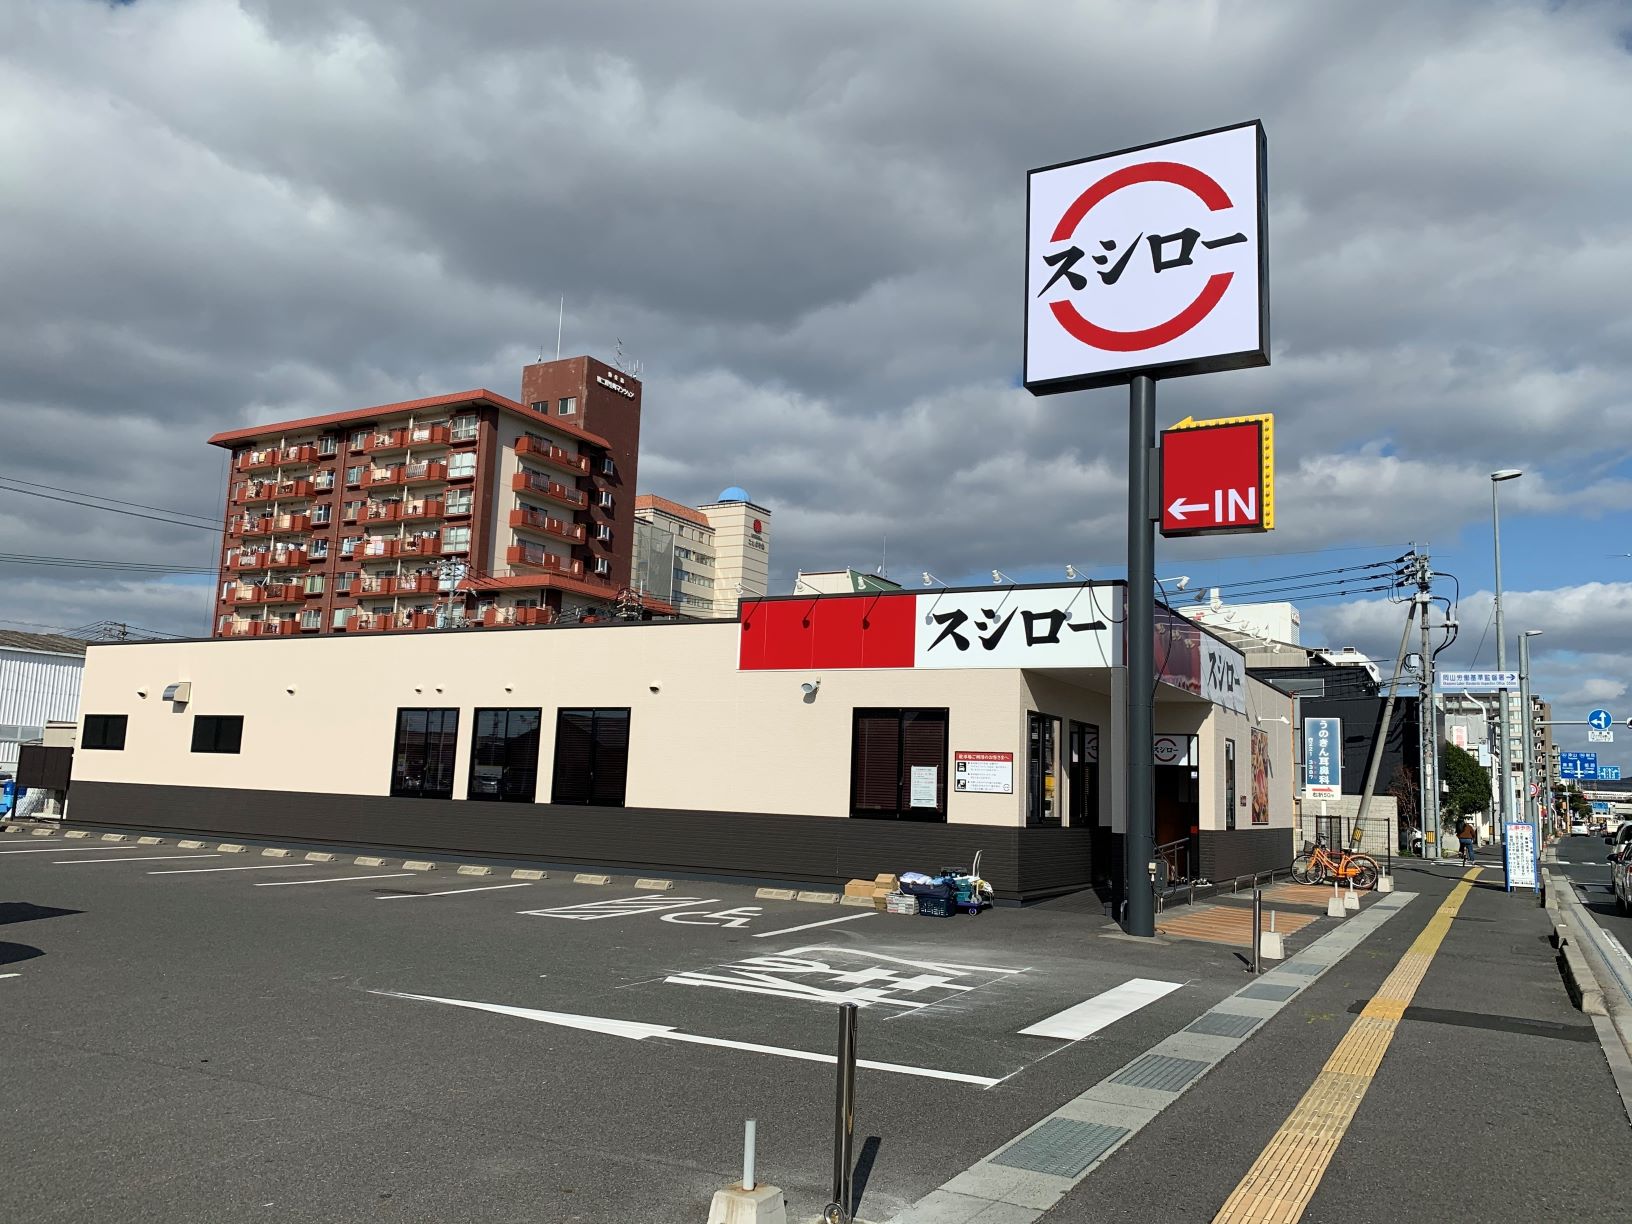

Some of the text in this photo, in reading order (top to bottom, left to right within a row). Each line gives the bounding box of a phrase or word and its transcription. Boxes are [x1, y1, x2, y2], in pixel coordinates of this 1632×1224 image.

[1037, 227, 1248, 298] スシロー
[1214, 487, 1256, 523] IN
[928, 605, 1108, 652] スシロー
[1208, 650, 1241, 692] スシロー
